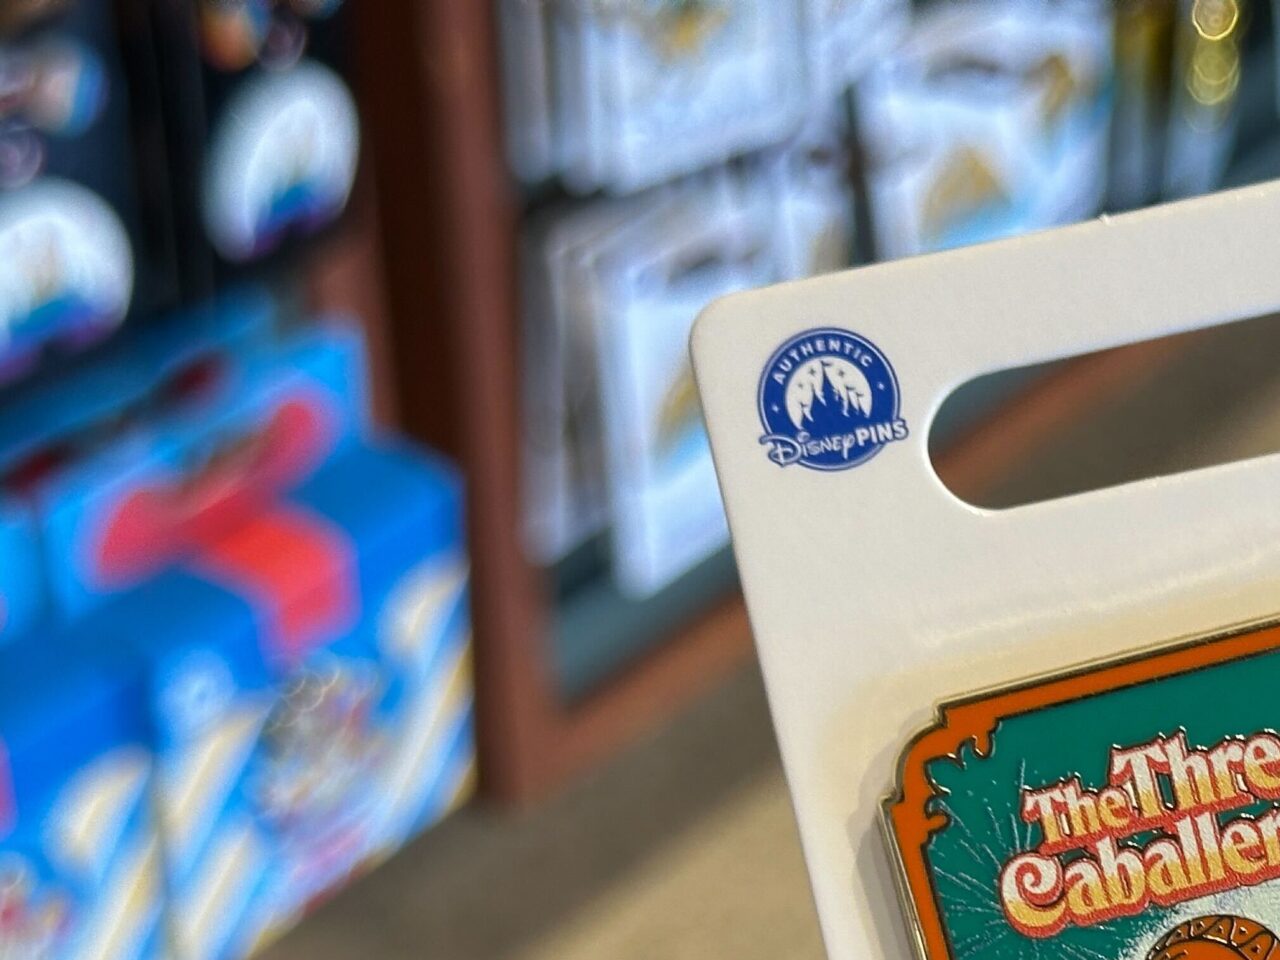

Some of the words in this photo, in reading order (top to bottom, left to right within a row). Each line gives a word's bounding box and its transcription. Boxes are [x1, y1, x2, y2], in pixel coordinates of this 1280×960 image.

[772, 338, 873, 385] AUTHENTIC
[854, 420, 908, 447] PINS
[1022, 778, 1132, 848] The
